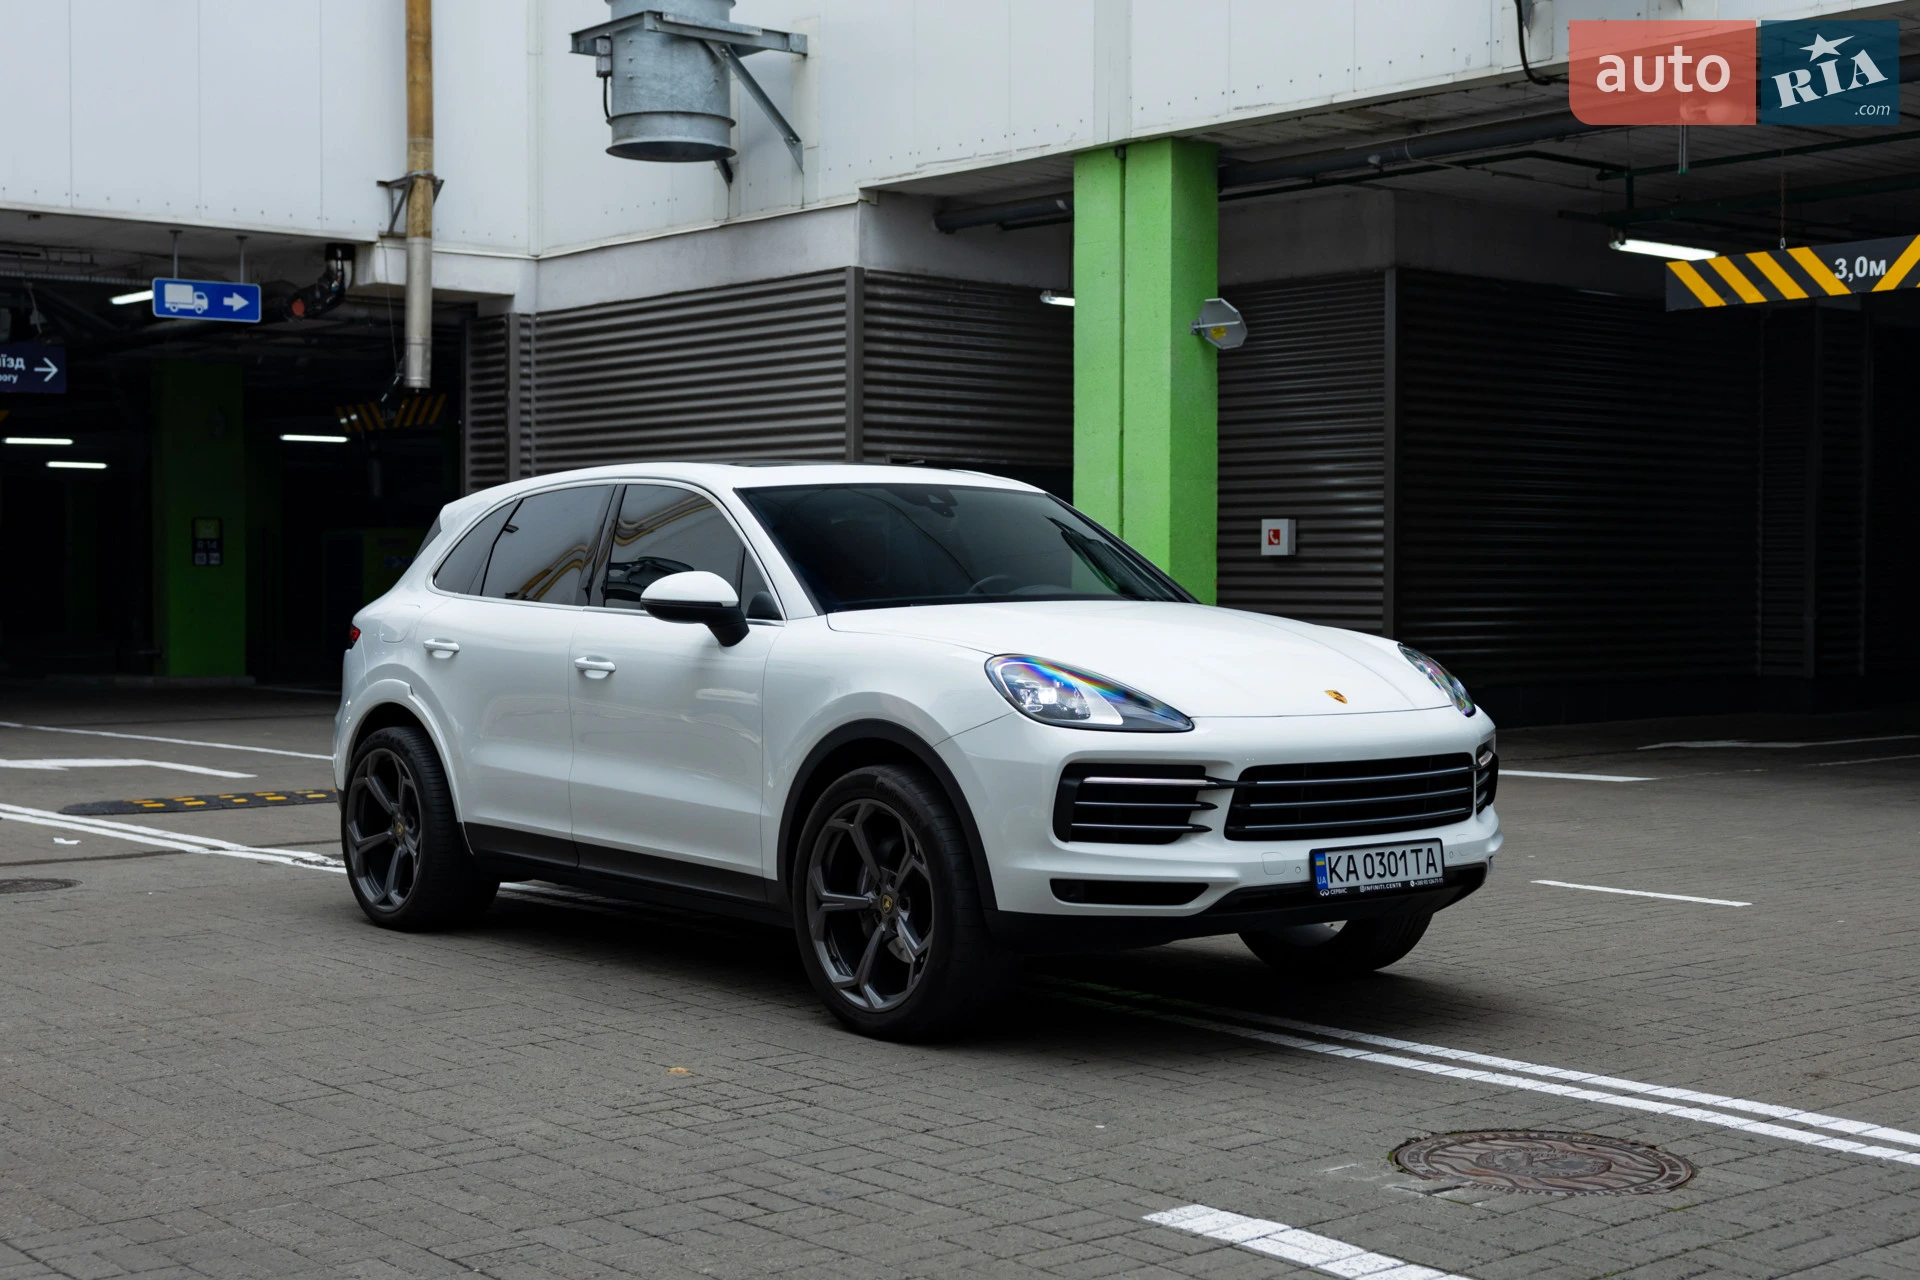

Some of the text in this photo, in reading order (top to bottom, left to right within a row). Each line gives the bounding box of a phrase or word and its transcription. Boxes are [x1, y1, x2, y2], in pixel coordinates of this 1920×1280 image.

[1834, 256, 1886, 282] 3,0м
[0, 354, 26, 370] їзд
[1316, 876, 1327, 885] UA
